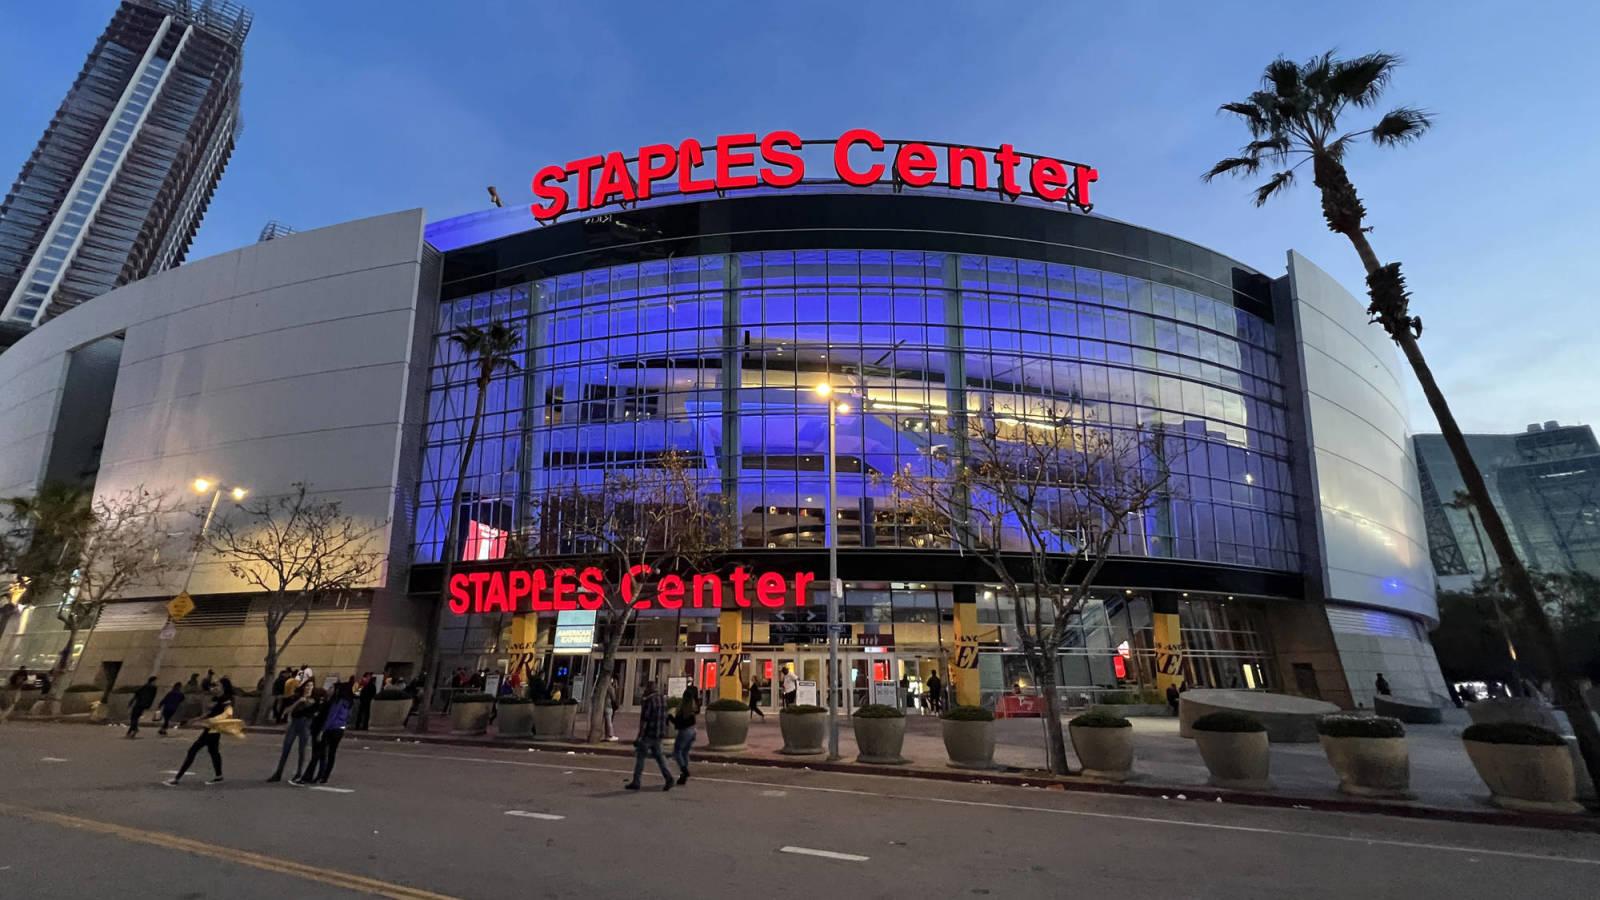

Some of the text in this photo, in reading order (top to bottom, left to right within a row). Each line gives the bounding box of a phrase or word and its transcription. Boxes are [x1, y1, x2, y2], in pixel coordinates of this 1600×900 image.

[531, 129, 1098, 220] STAPLES Center
[449, 564, 815, 614] STAPLES Center
